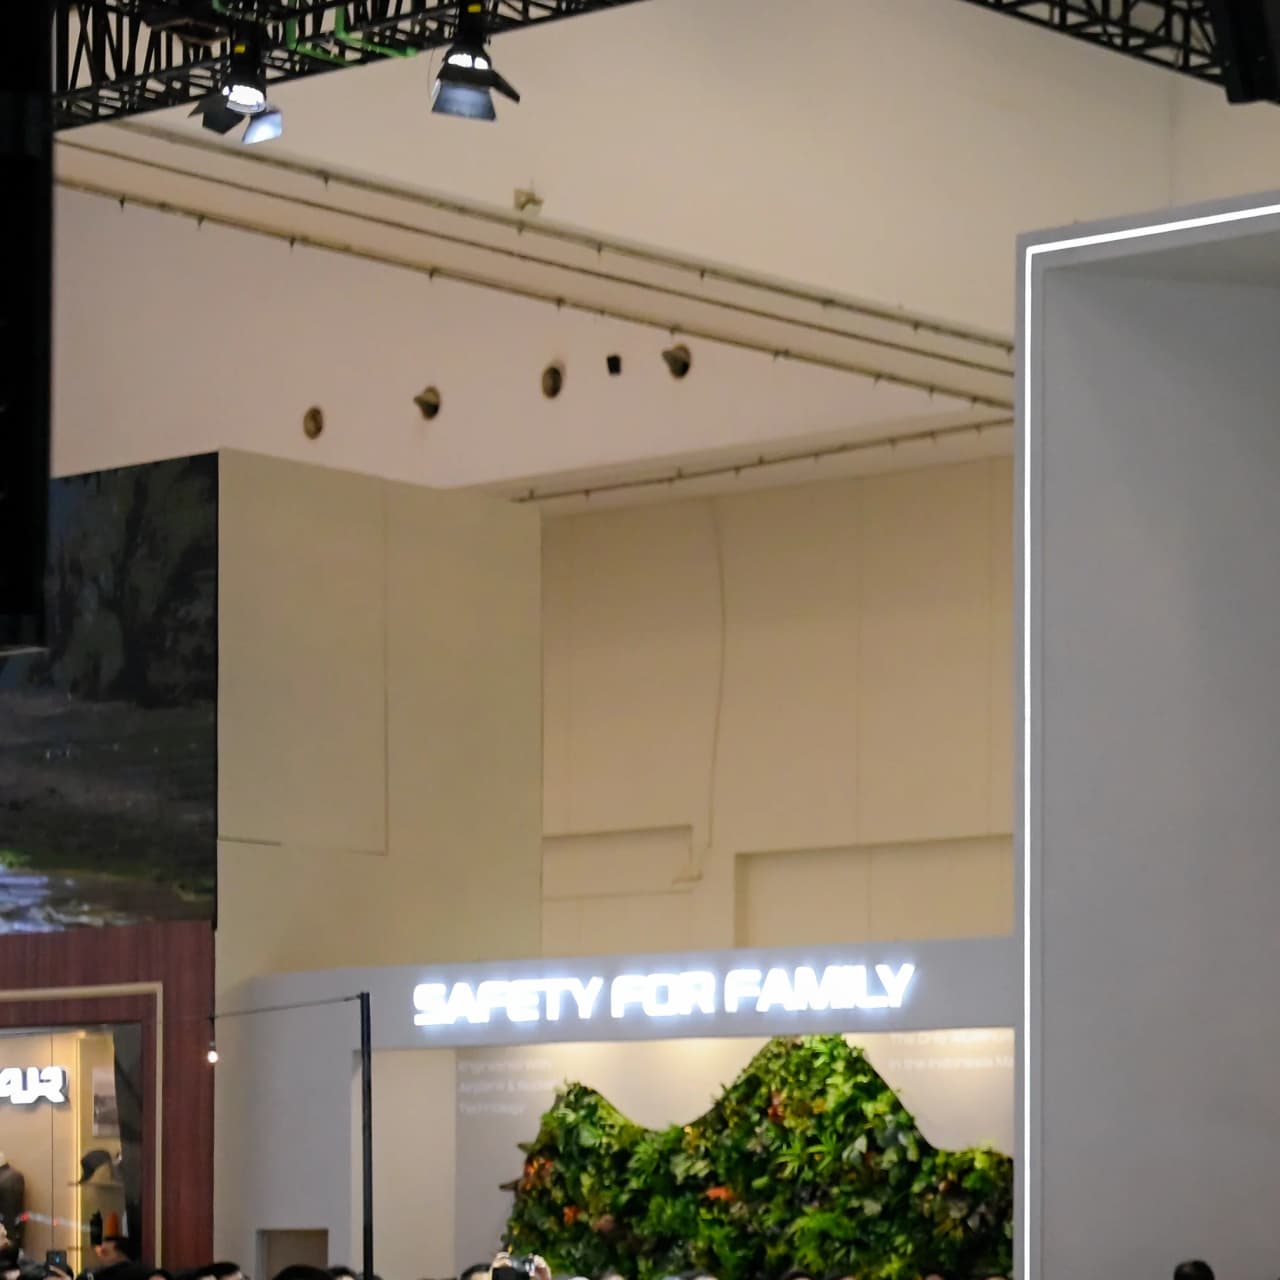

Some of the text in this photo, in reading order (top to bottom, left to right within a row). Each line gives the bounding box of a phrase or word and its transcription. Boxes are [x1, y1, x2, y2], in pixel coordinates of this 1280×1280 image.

[413, 962, 915, 1026] SAFETY FOR FAMILY
